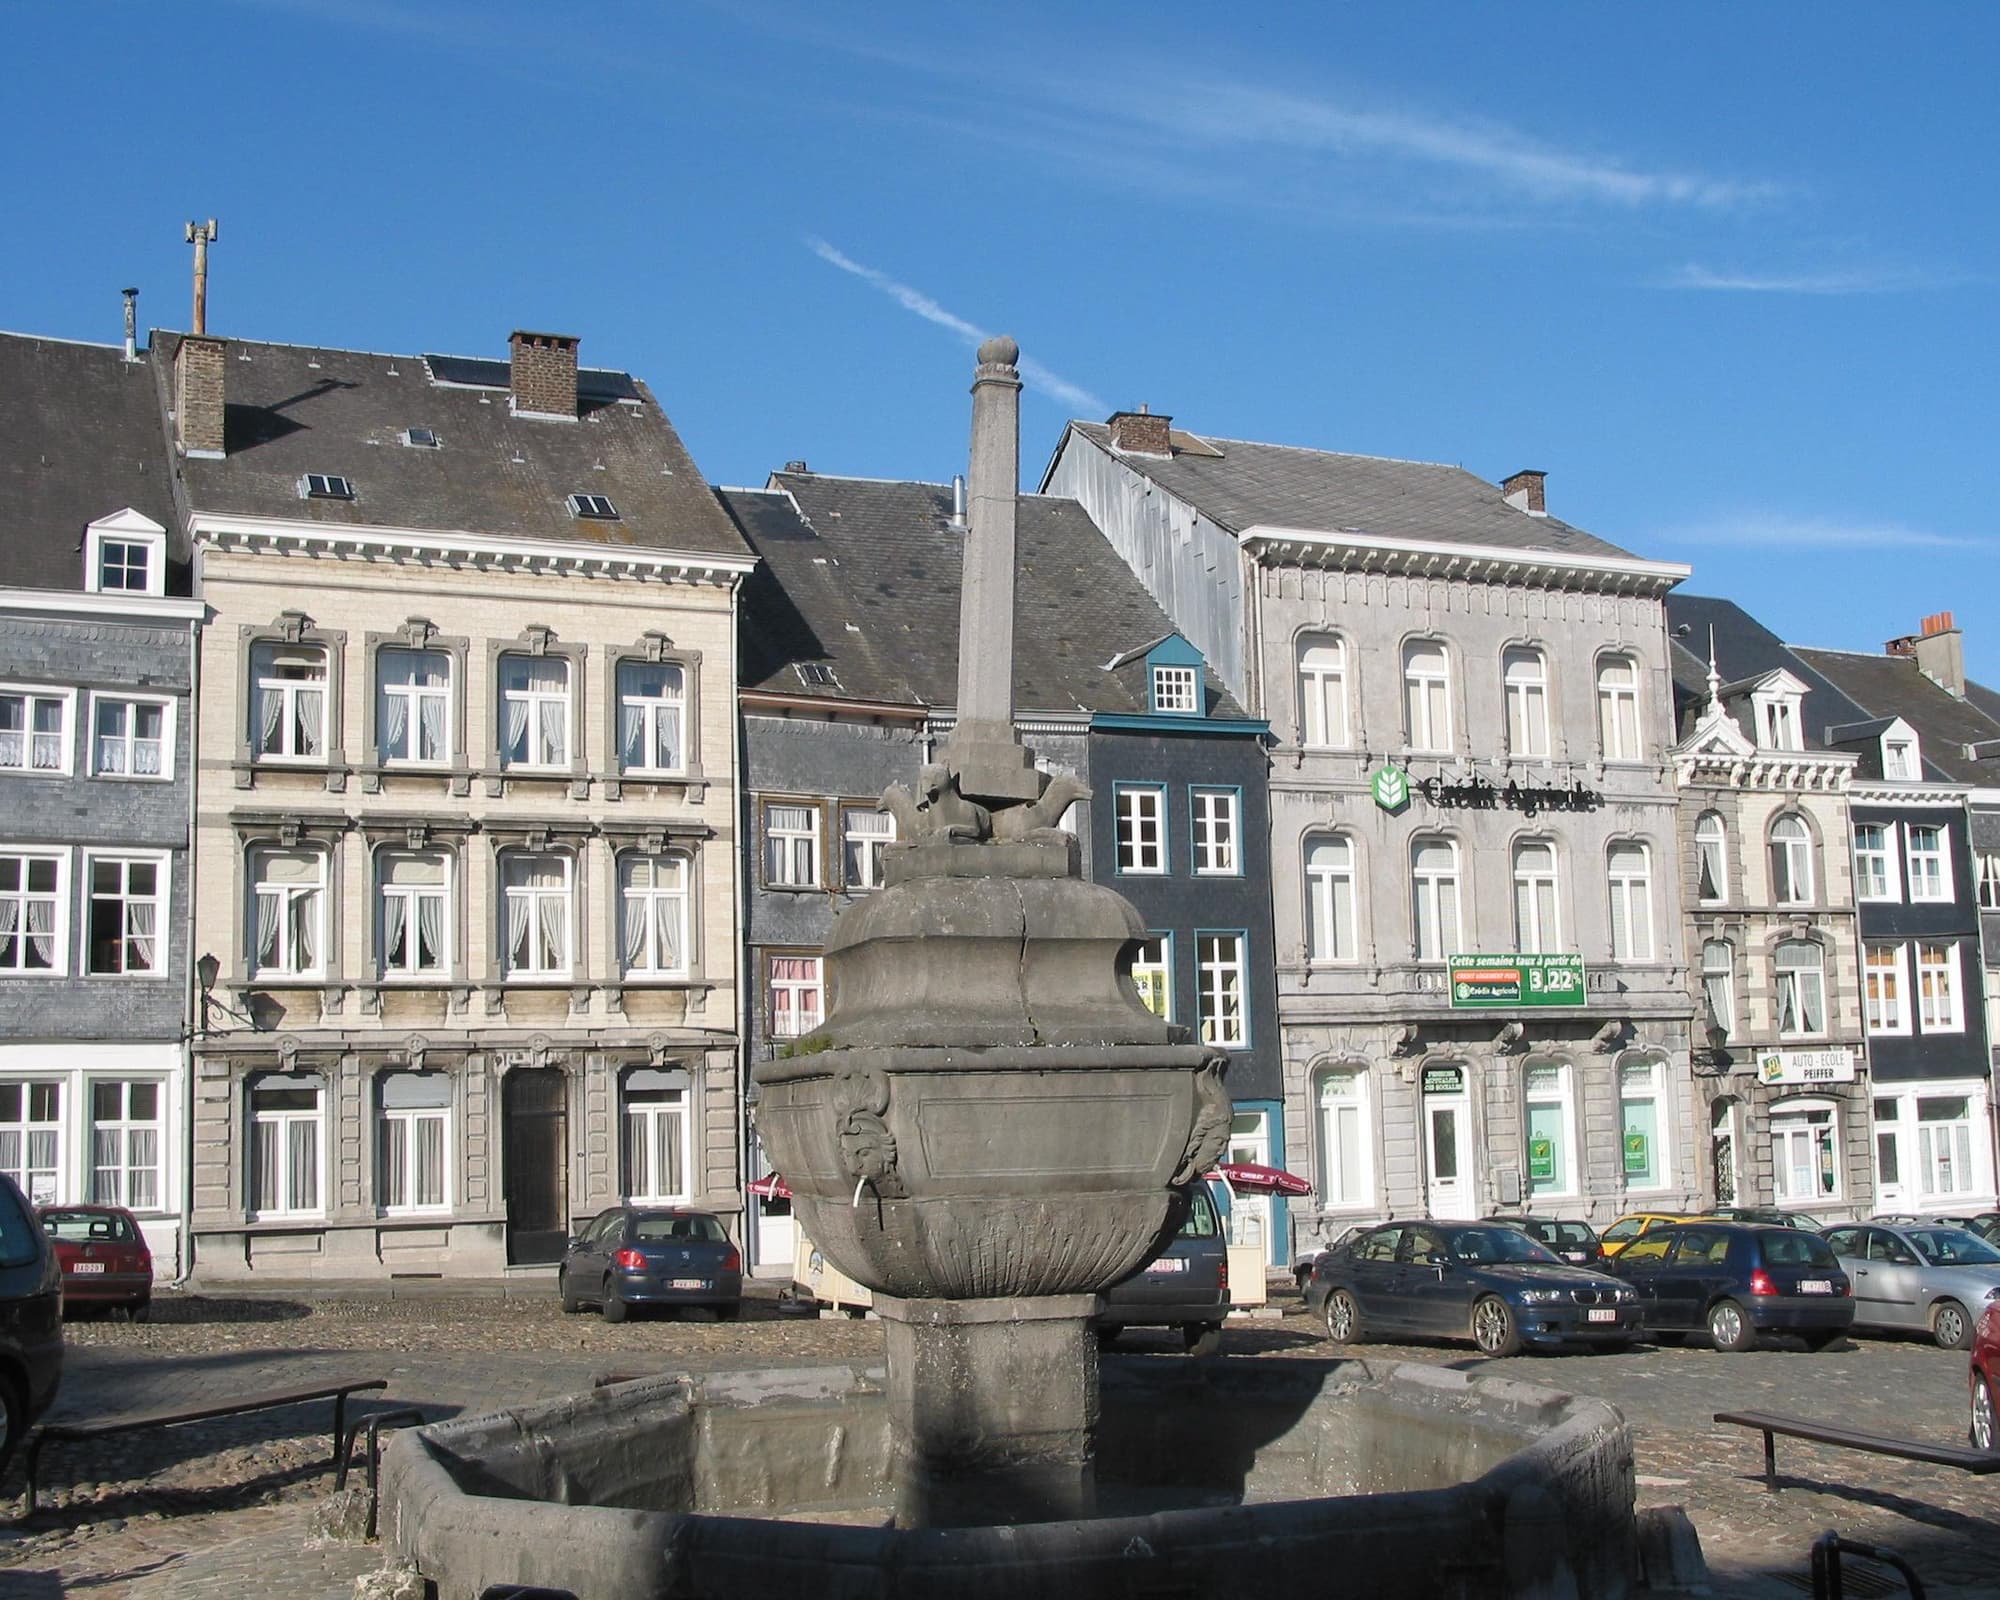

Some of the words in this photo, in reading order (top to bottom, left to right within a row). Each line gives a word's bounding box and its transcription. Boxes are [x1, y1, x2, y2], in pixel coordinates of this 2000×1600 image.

[1450, 956, 1474, 966] Cette
[1476, 955, 1514, 966] semaine
[1516, 955, 1536, 966] taux
[1536, 955, 1543, 966] à
[1543, 955, 1571, 968] partir
[1572, 955, 1582, 966] de
[1792, 1054, 1813, 1067] AUTO
[1821, 1054, 1845, 1066] ECOLE
